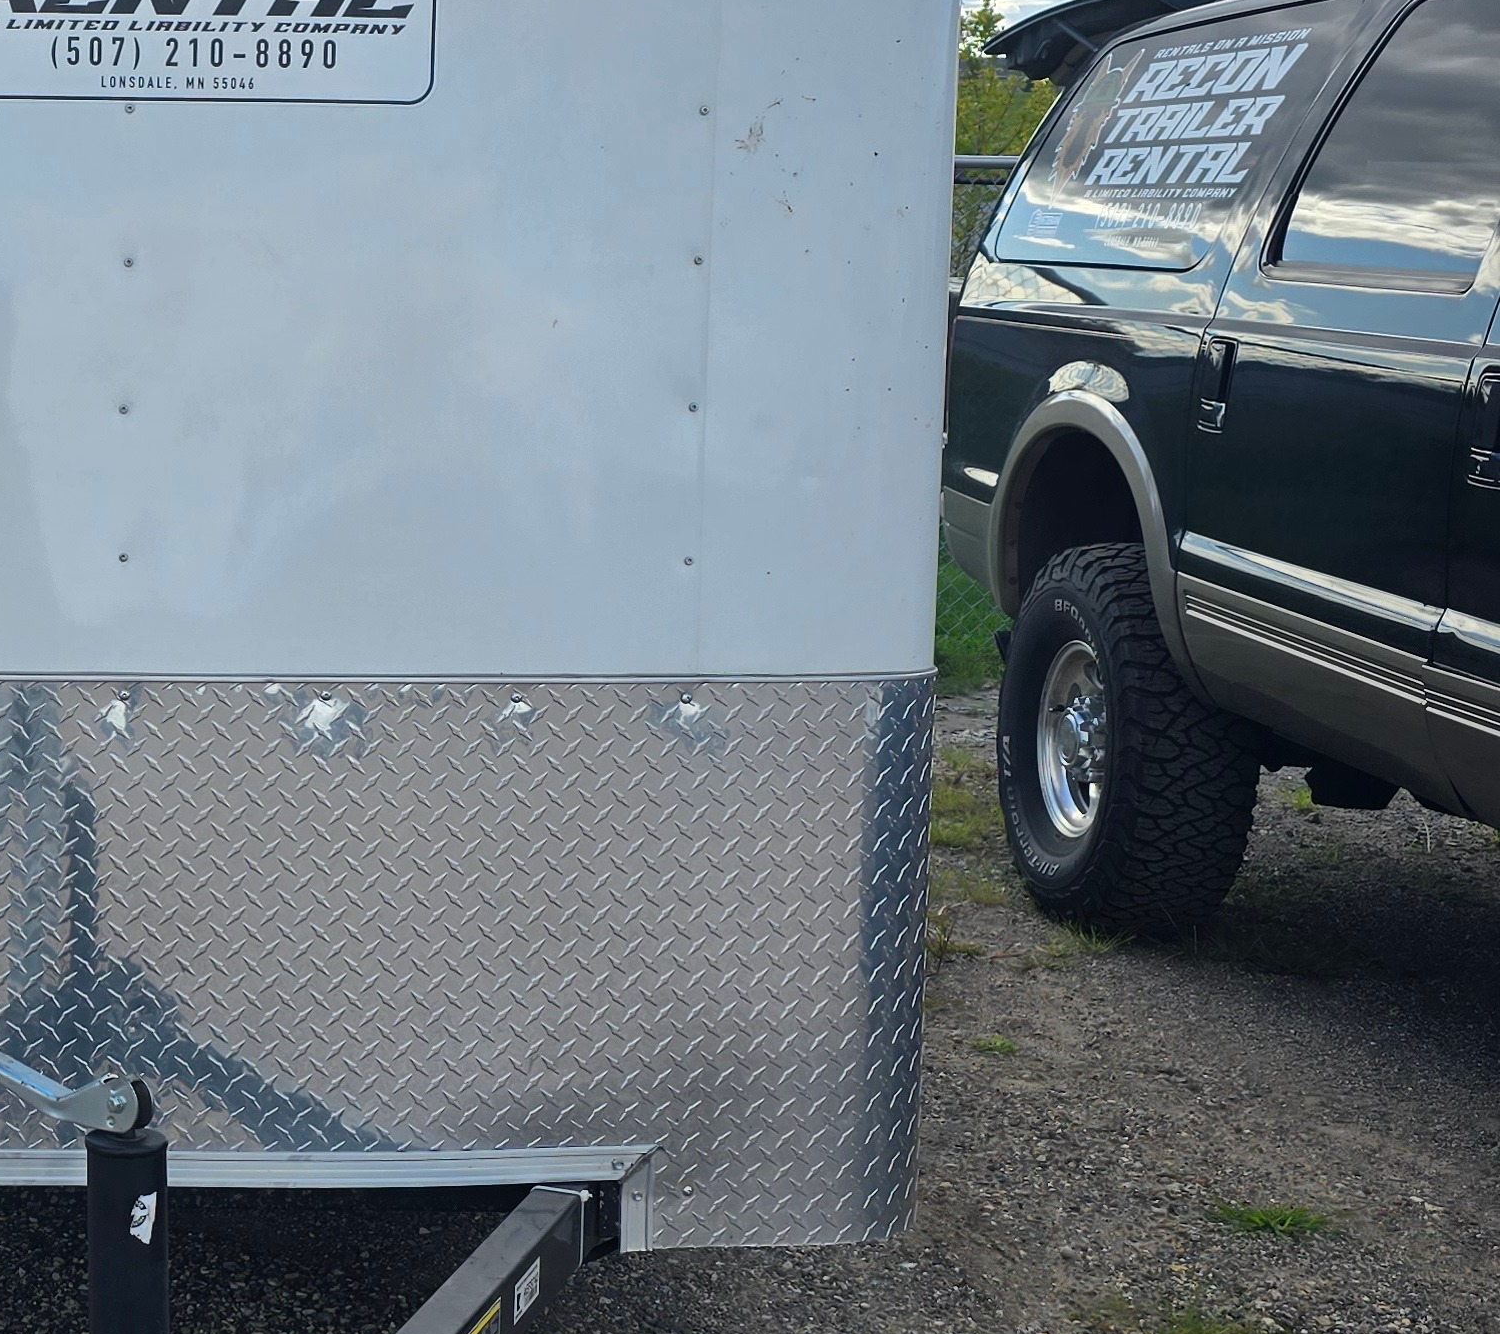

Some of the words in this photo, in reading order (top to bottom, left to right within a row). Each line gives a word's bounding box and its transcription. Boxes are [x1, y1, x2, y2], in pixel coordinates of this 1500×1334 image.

[5, 19, 120, 31] LIMITED
[127, 20, 266, 33] LIABILITY
[273, 22, 407, 35] COMPANY
[1153, 42, 1209, 59] RENTALS
[1213, 39, 1235, 51] ON
[1234, 37, 1249, 48] A
[1249, 27, 1313, 47] MISSION
[51, 36, 141, 69] (507)
[165, 37, 337, 69] 210-8890
[100, 75, 178, 90] LONSDALE,
[185, 77, 205, 89] MN
[212, 77, 255, 90] 55046
[1123, 43, 1309, 104] RECON
[1104, 95, 1286, 144] TRAILER
[1084, 142, 1252, 185] RENTAL
[1084, 189, 1092, 198] A
[1092, 189, 1131, 198] LIMITED
[1130, 188, 1182, 198] LIABILITY
[1182, 188, 1238, 198] COMPANY
